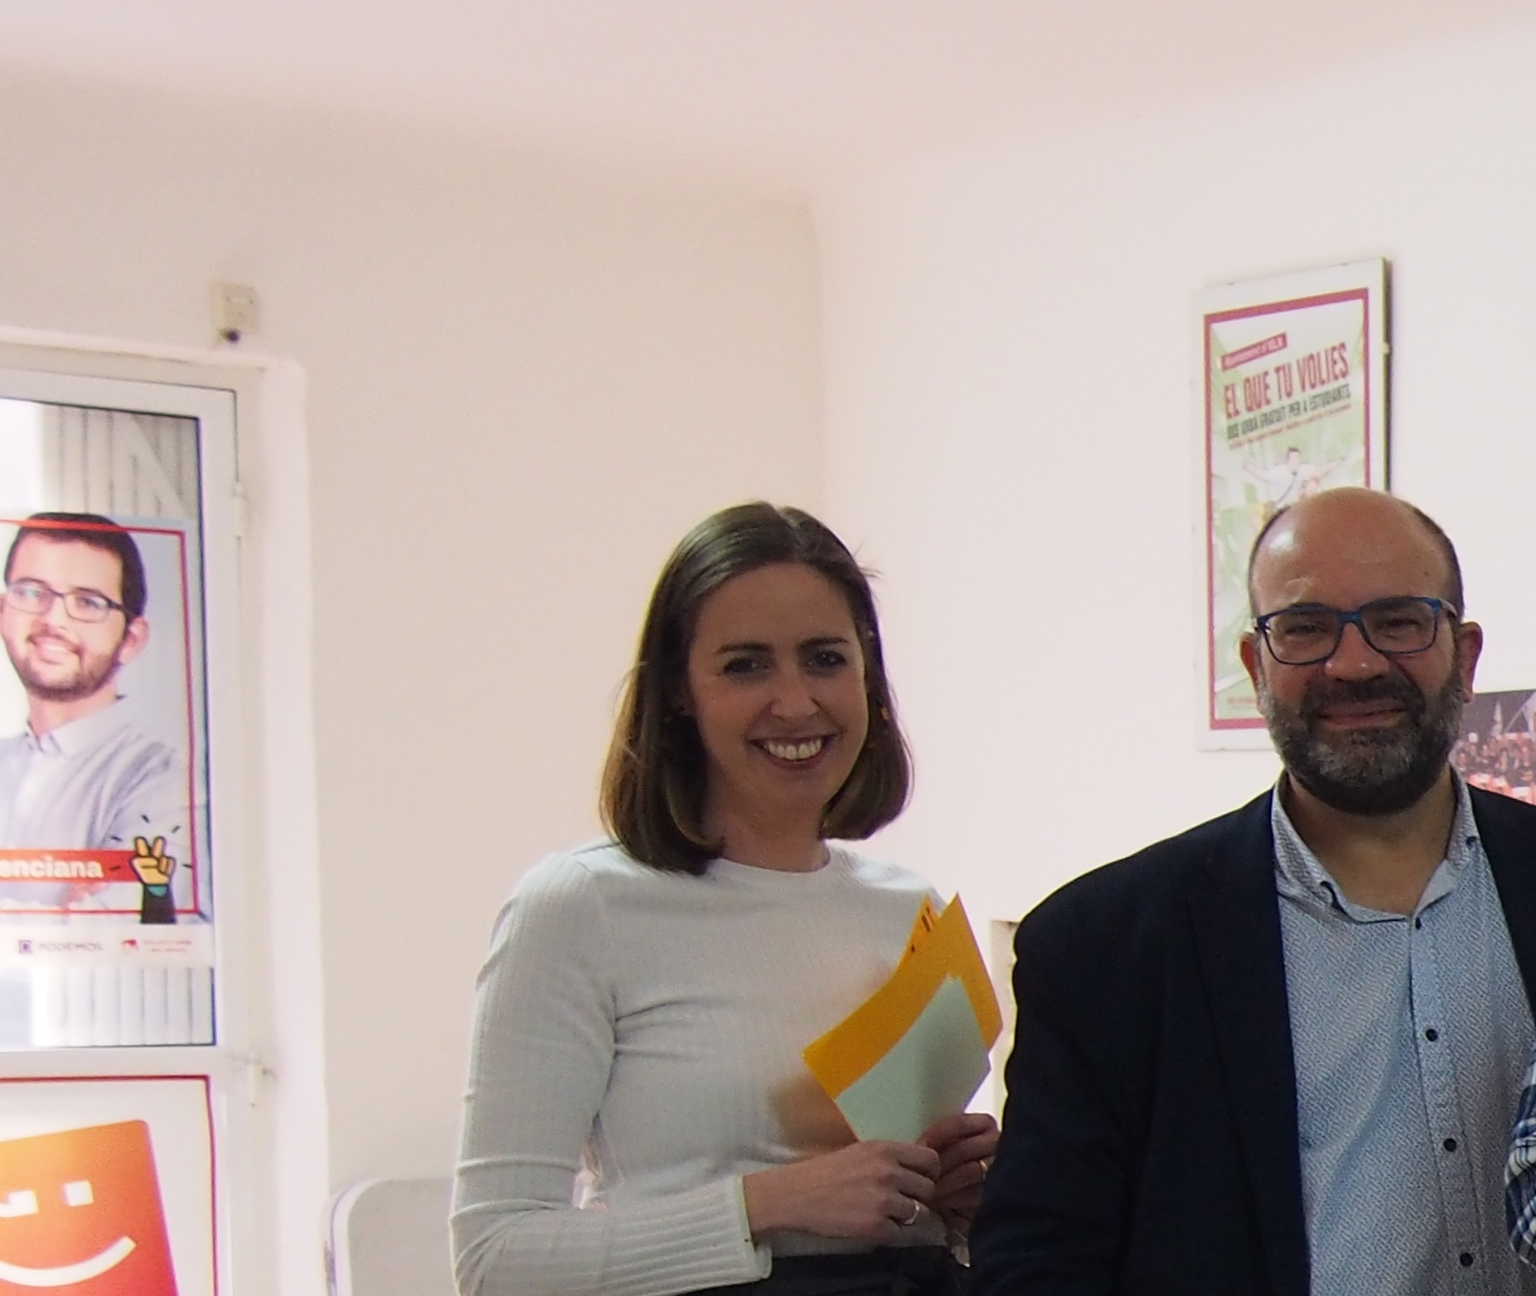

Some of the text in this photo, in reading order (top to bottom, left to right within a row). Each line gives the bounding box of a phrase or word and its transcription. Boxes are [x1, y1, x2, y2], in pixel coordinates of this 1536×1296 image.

[1224, 383, 1240, 420] EL
[1243, 371, 1271, 412] QUE
[1274, 361, 1294, 401] TU
[1297, 343, 1349, 392] VOLIES
